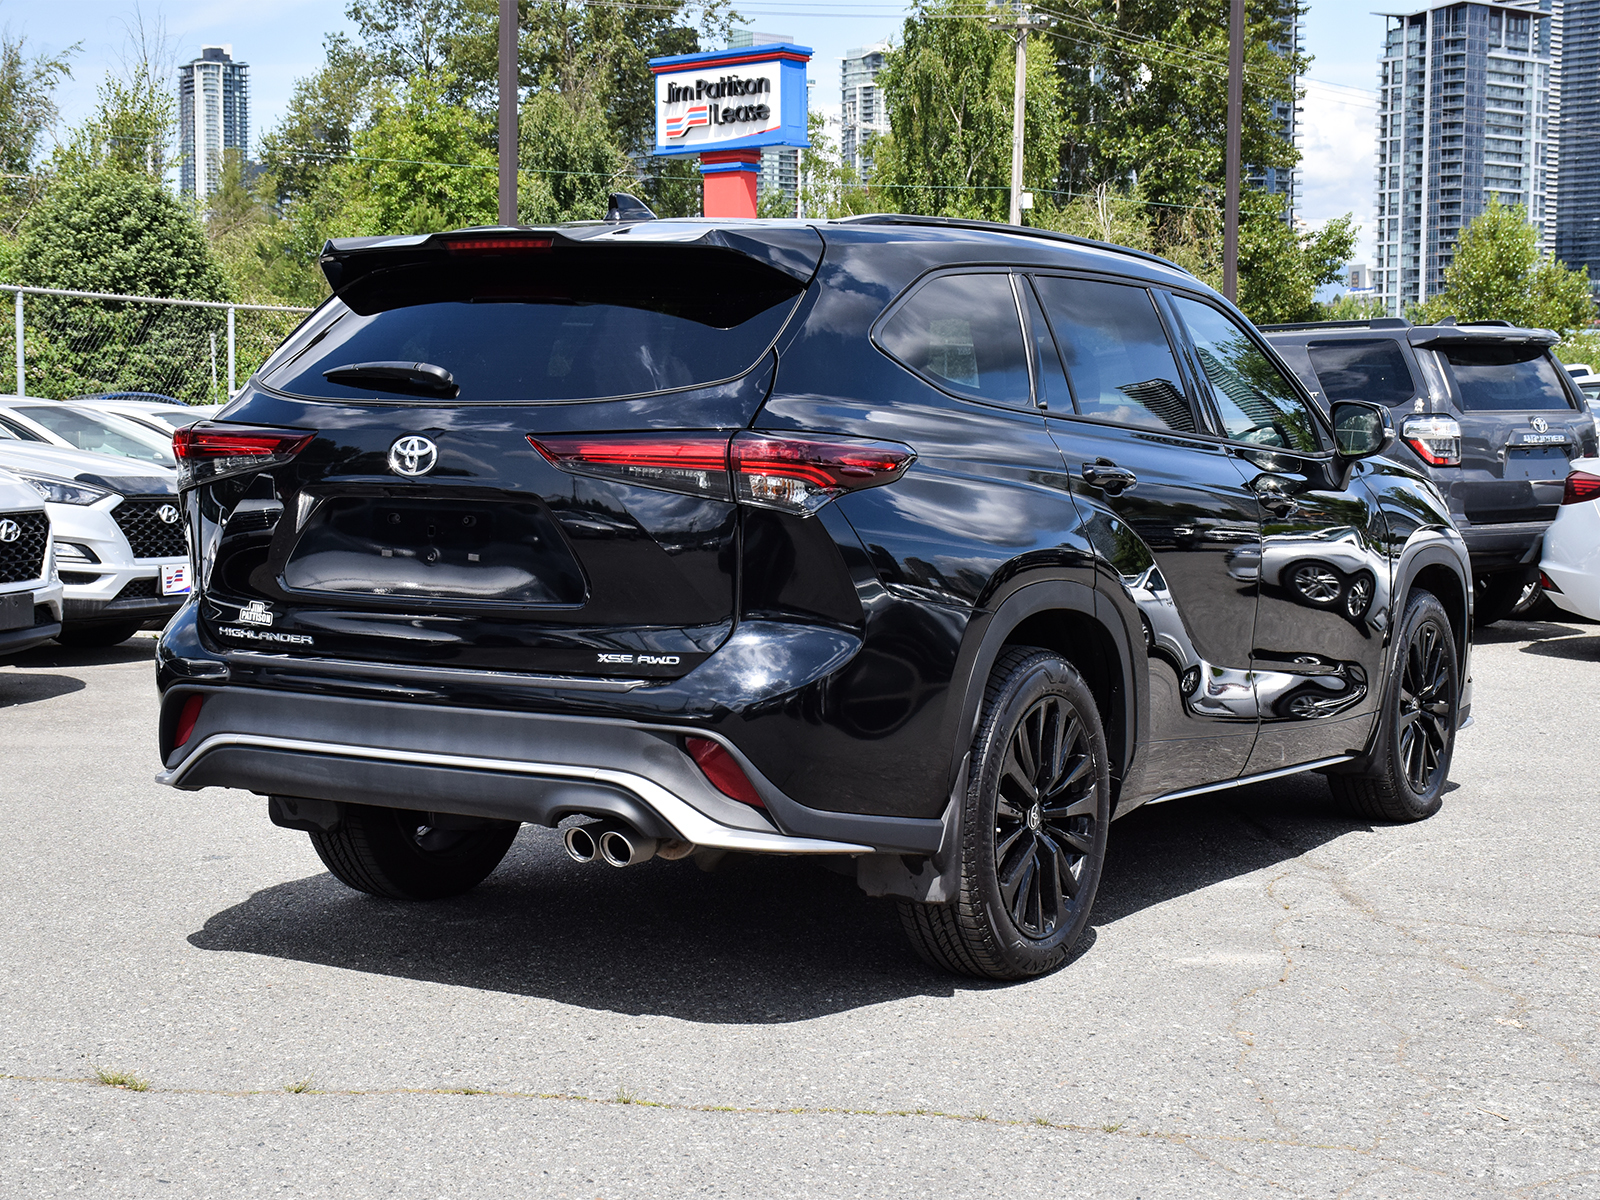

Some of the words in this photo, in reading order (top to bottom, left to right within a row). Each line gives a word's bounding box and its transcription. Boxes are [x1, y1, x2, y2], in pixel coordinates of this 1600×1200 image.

[662, 82, 694, 104] Jim
[695, 75, 771, 100] Pattison
[713, 103, 771, 125] Lease
[250, 603, 264, 612] JIM
[241, 610, 271, 623] PATTISON
[219, 627, 314, 644] HIGHLANDER
[597, 653, 633, 663] XSE
[638, 654, 680, 665] AWD
